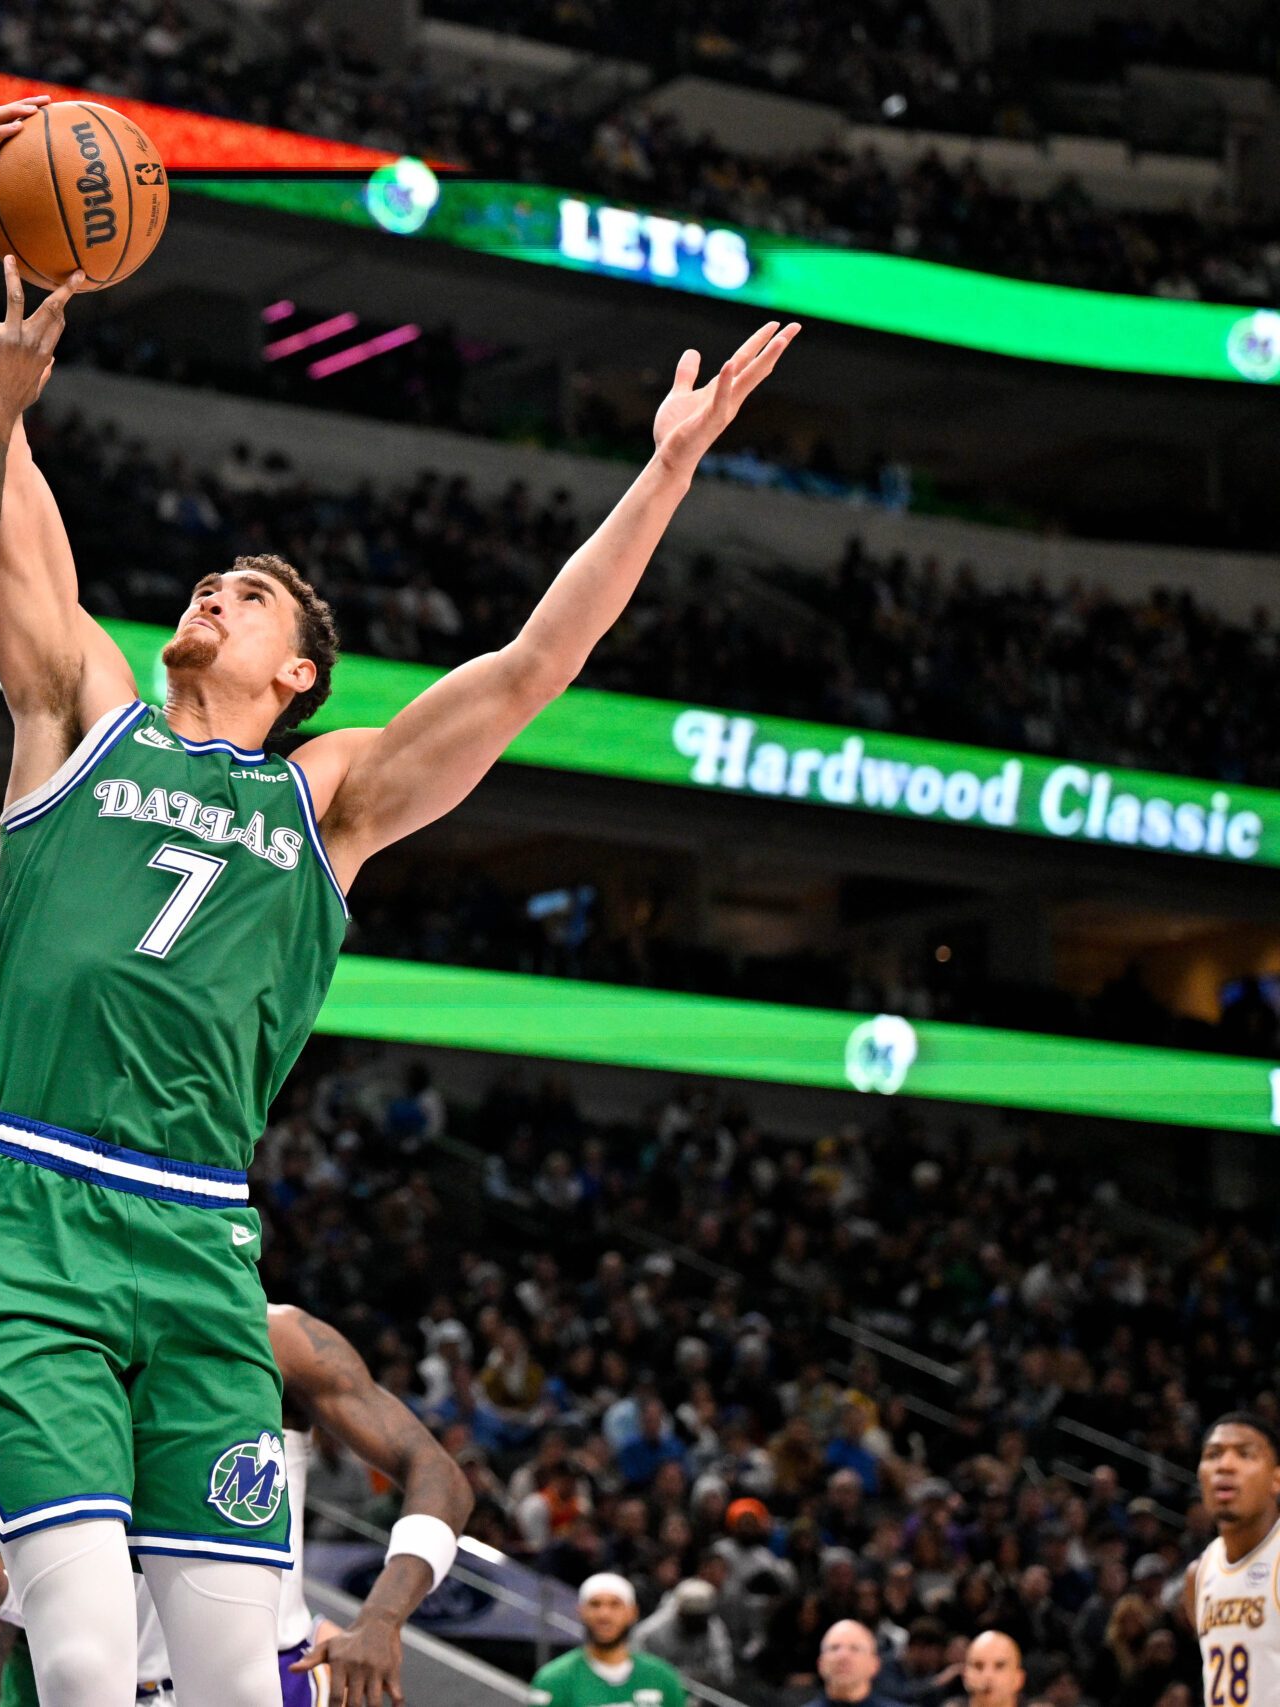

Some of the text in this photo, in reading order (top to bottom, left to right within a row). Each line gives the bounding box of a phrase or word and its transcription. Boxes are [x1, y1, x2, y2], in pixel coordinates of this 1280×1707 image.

[72, 121, 118, 249] Wilson
[559, 199, 750, 290] LET'S
[141, 726, 175, 748] NIKE
[230, 769, 289, 783] chime
[94, 779, 303, 870] DALLAS
[672, 709, 1262, 859] Hardwood Classic
[134, 843, 228, 960] 7
[1208, 1643, 1251, 1707] 28
